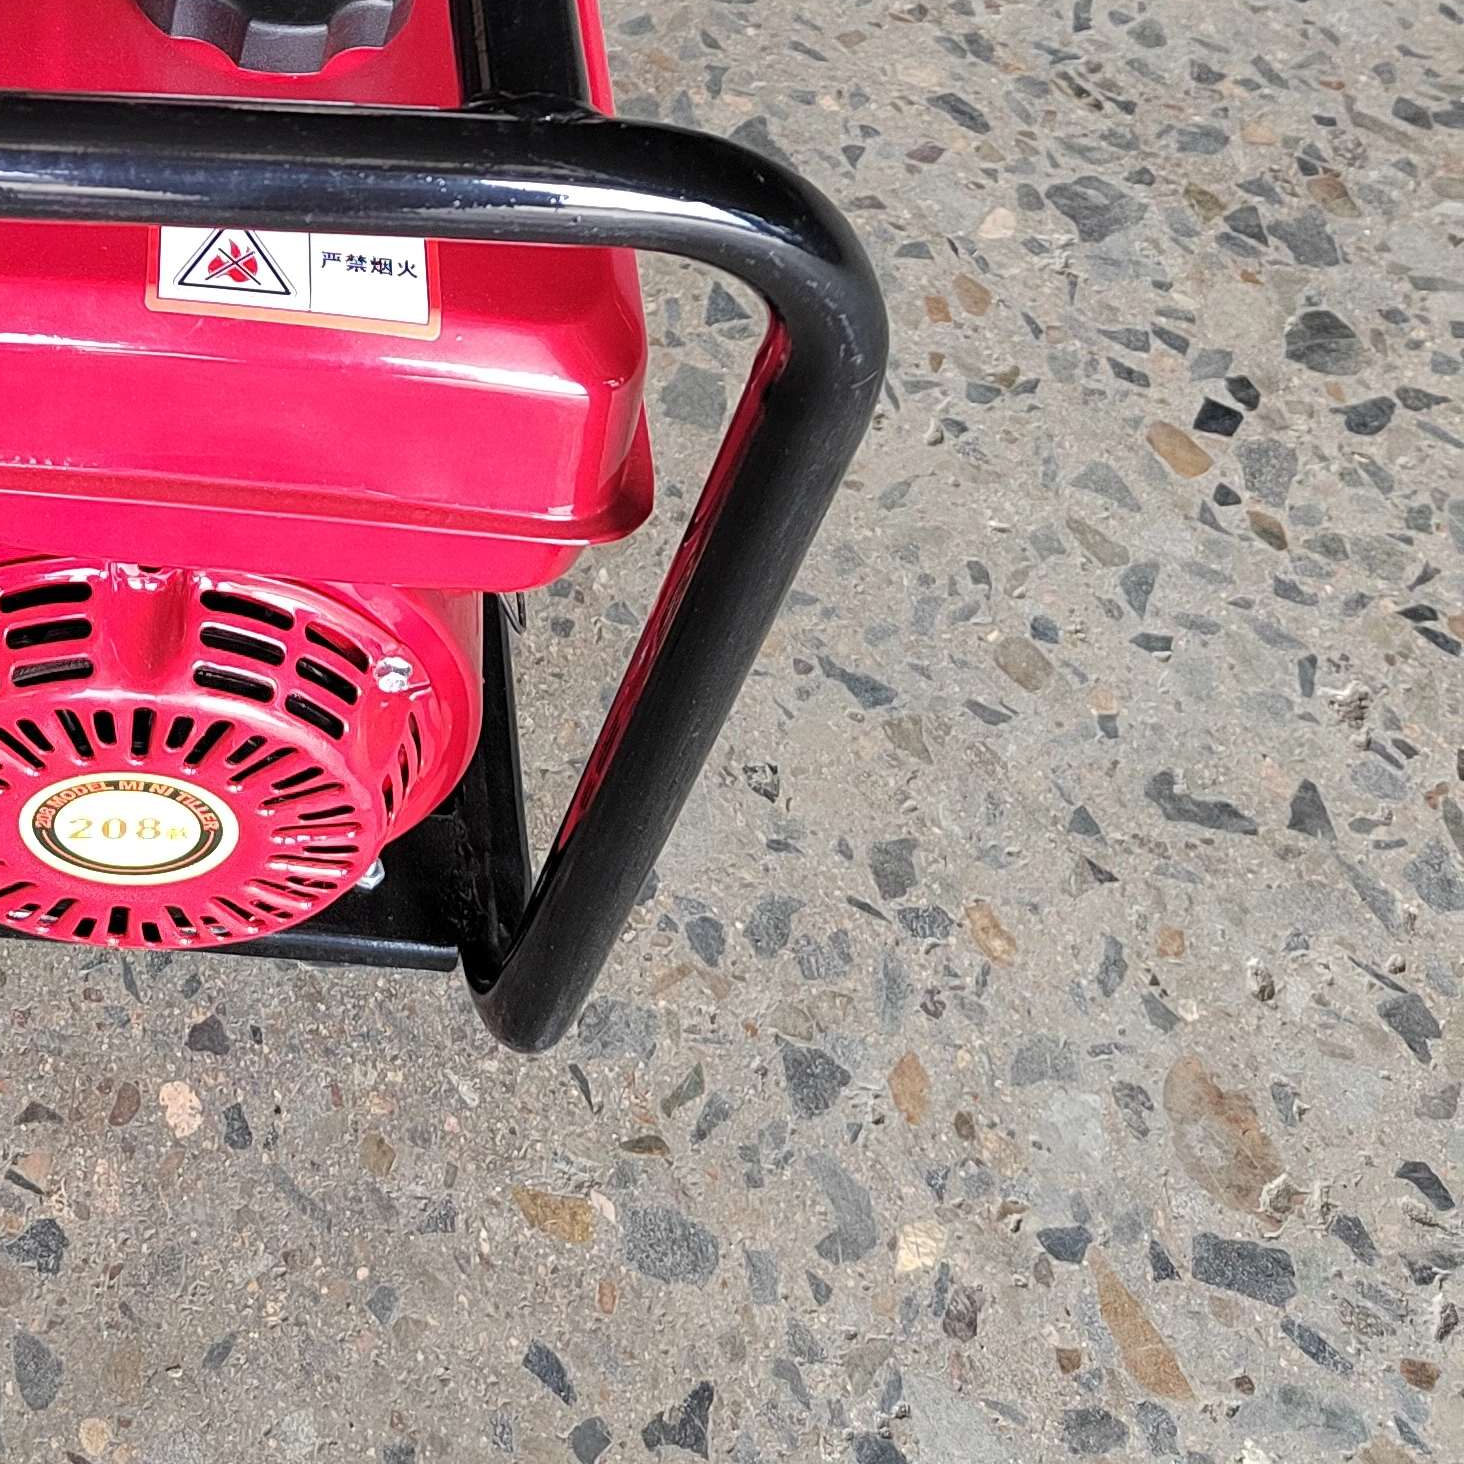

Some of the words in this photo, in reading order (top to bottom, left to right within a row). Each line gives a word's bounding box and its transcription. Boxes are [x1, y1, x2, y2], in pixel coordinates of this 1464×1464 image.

[321, 250, 418, 279] 严禁烟火
[35, 806, 56, 829] 208
[46, 780, 115, 808] MODEL
[175, 790, 220, 832] TILLER
